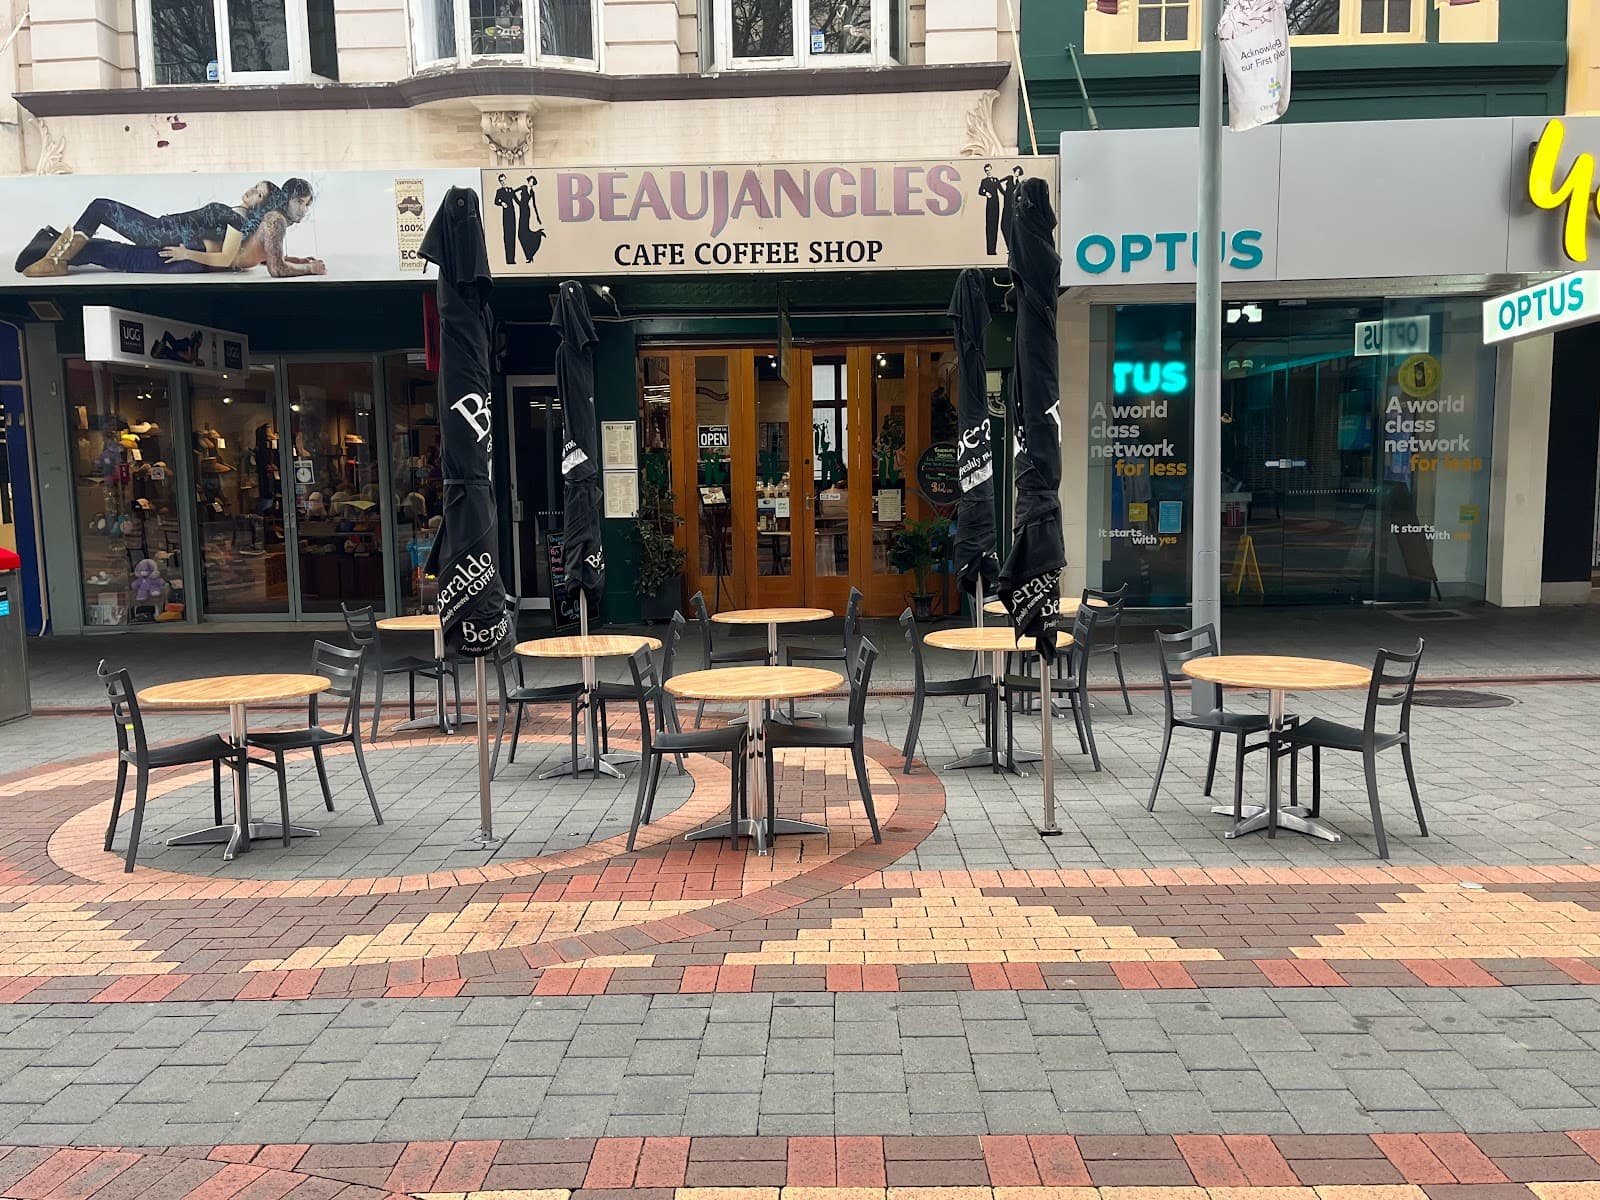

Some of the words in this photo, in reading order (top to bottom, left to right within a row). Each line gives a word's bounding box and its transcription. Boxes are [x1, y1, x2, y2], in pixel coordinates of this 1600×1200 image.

[1241, 62, 1254, 72] our
[1255, 56, 1273, 68] First
[1528, 118, 1600, 263] y
[556, 164, 963, 239] BEAUJANGLES
[399, 224, 424, 232] 100%
[401, 249, 422, 260] EC
[614, 243, 685, 266] CAFE
[694, 242, 800, 265] COFFEE
[808, 240, 883, 264] SHOP
[1498, 277, 1584, 331] OPTUS
[122, 326, 142, 341] UGG
[1091, 401, 1108, 419] A
[1112, 400, 1168, 419] world
[1385, 396, 1402, 414] A
[1407, 395, 1465, 413] world
[1091, 421, 1140, 438] class
[1385, 415, 1435, 433] class
[700, 432, 728, 446] OPEN
[1384, 434, 1472, 453] network
[1091, 439, 1174, 458] network
[1115, 459, 1145, 477] for
[1149, 458, 1187, 476] less
[1410, 454, 1440, 472] for
[1098, 528, 1107, 538] It
[1108, 528, 1142, 538] starts
[1390, 523, 1400, 533] It
[1401, 524, 1436, 533] starts
[1425, 531, 1451, 541] with
[1132, 534, 1157, 545] with
[1158, 536, 1177, 547] yes
